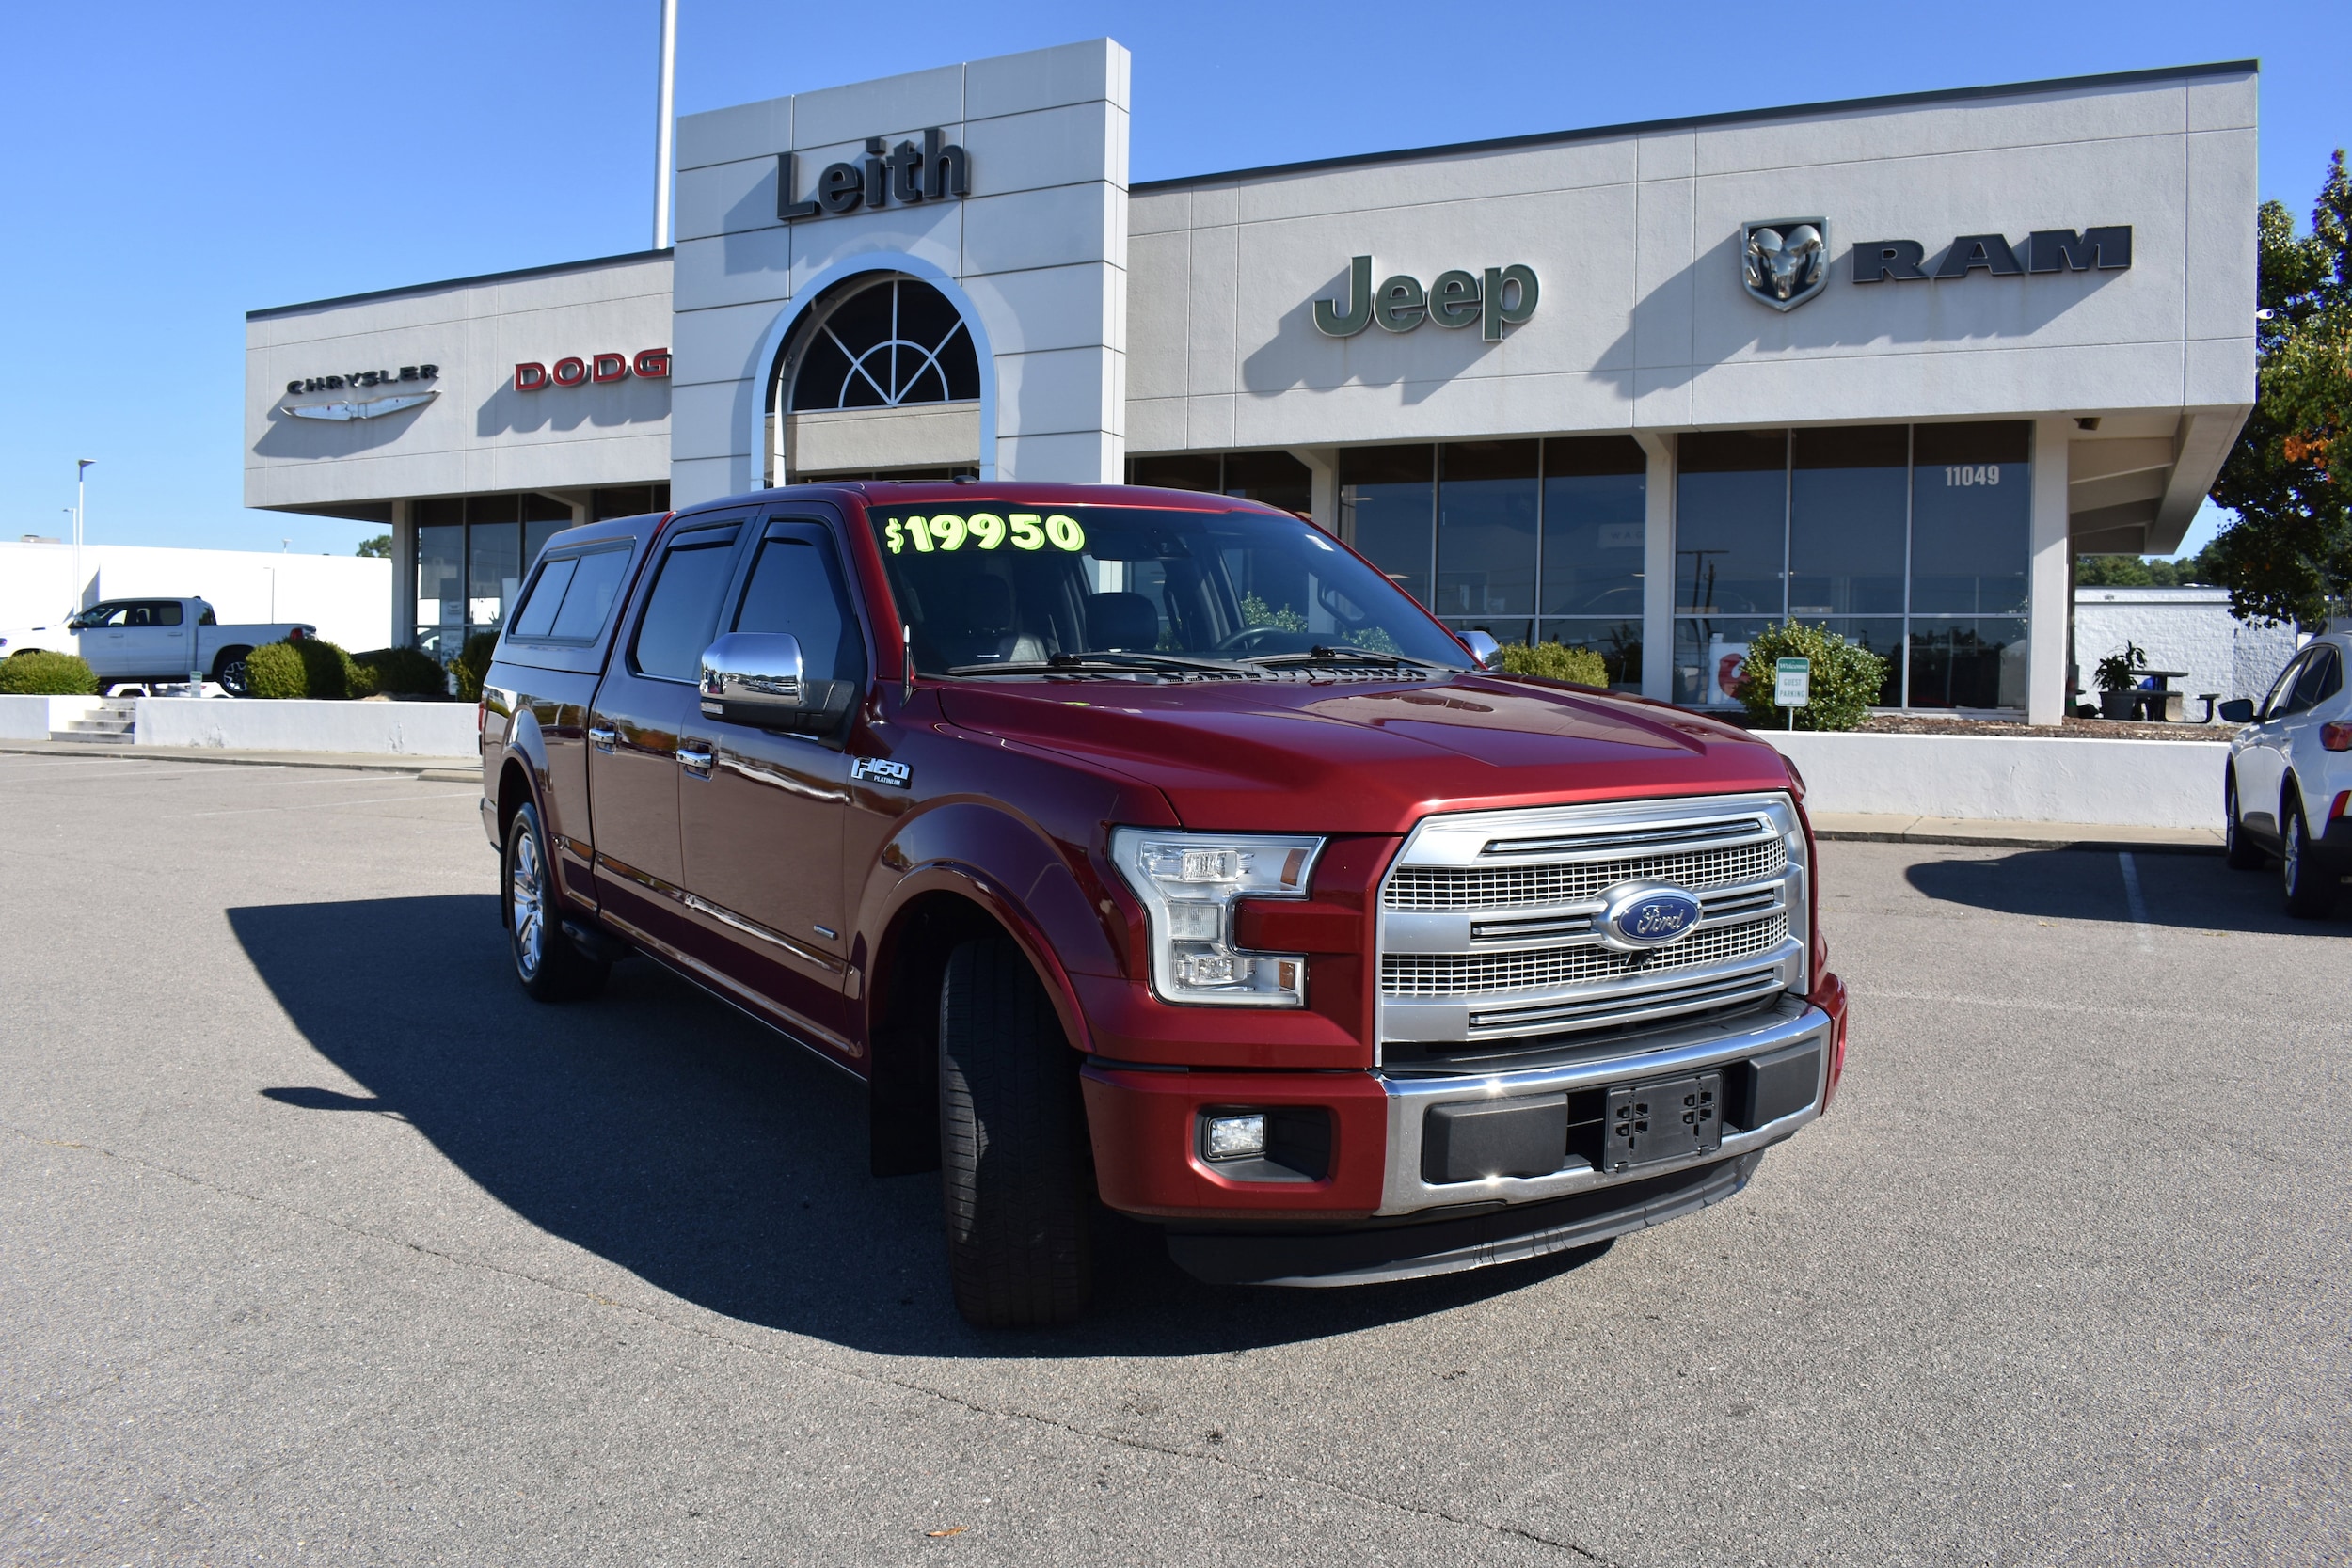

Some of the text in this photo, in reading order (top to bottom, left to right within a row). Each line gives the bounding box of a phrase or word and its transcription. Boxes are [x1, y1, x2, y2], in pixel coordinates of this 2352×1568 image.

[777, 128, 970, 219] Leith
[1852, 225, 2133, 283] RAM
[1313, 255, 1541, 341] Jeep
[287, 364, 439, 394] CHRYSLER
[515, 347, 672, 391] DODG
[1945, 465, 2000, 486] 11049
[884, 513, 1086, 555] $19950
[1779, 661, 1807, 670] Welcome
[873, 775, 900, 786] PLATINUM
[1637, 904, 1685, 934] Ford
